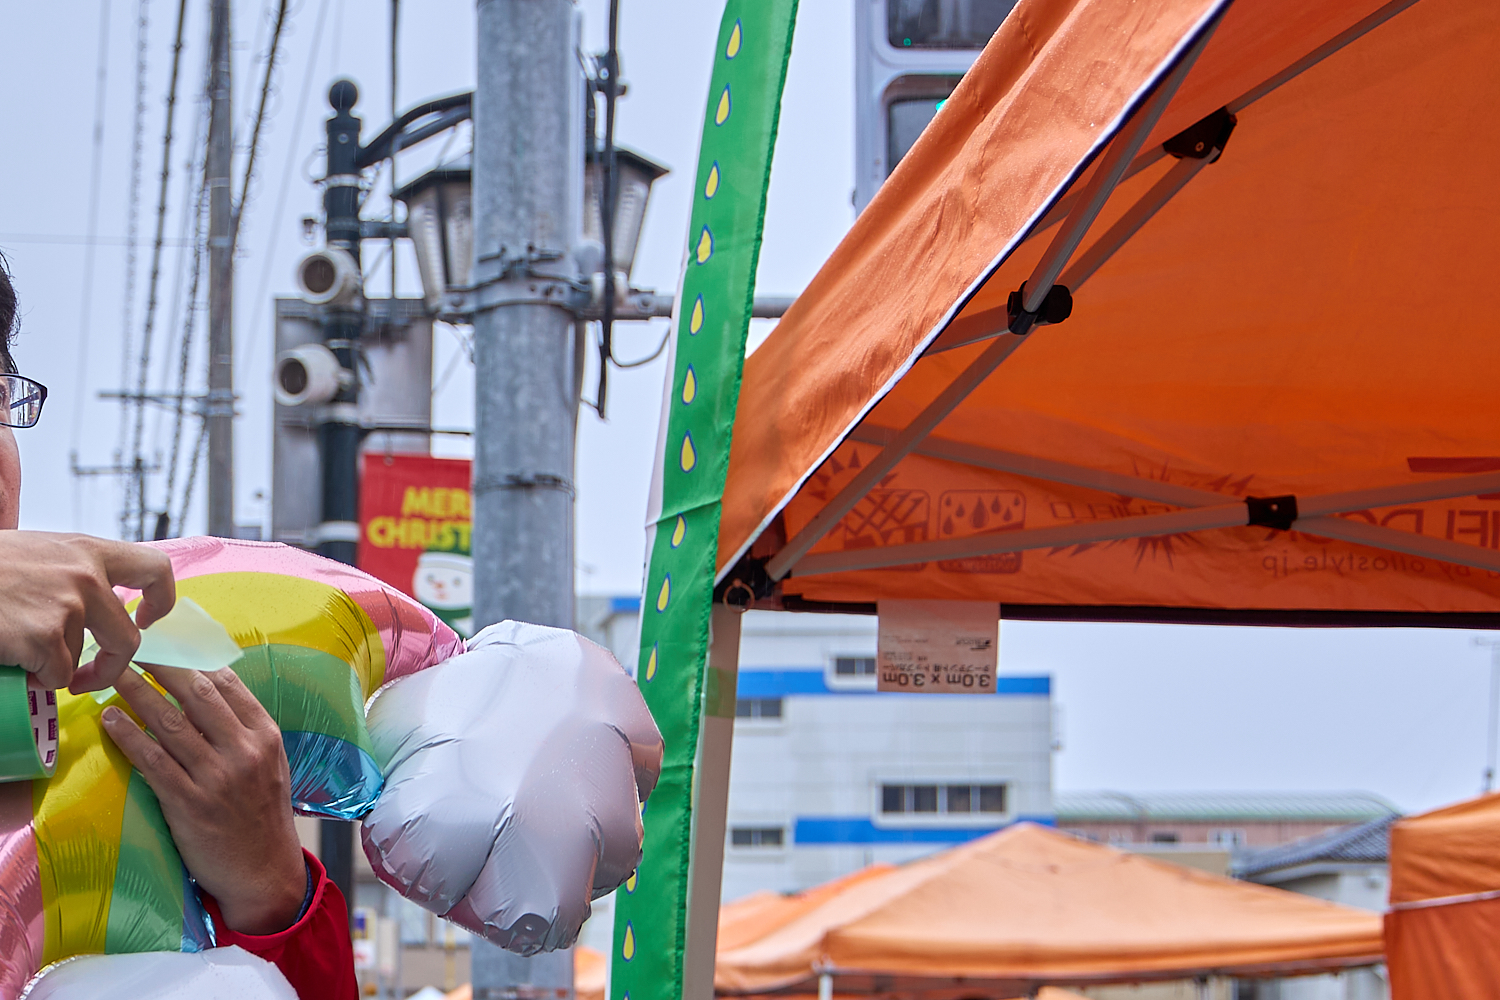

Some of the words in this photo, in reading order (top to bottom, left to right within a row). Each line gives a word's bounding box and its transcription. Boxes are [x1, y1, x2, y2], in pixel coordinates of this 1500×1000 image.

[402, 487, 471, 515] MER
[367, 516, 471, 551] CHRIST
[883, 673, 925, 687] 3.0m
[946, 674, 991, 688] 3.0m
